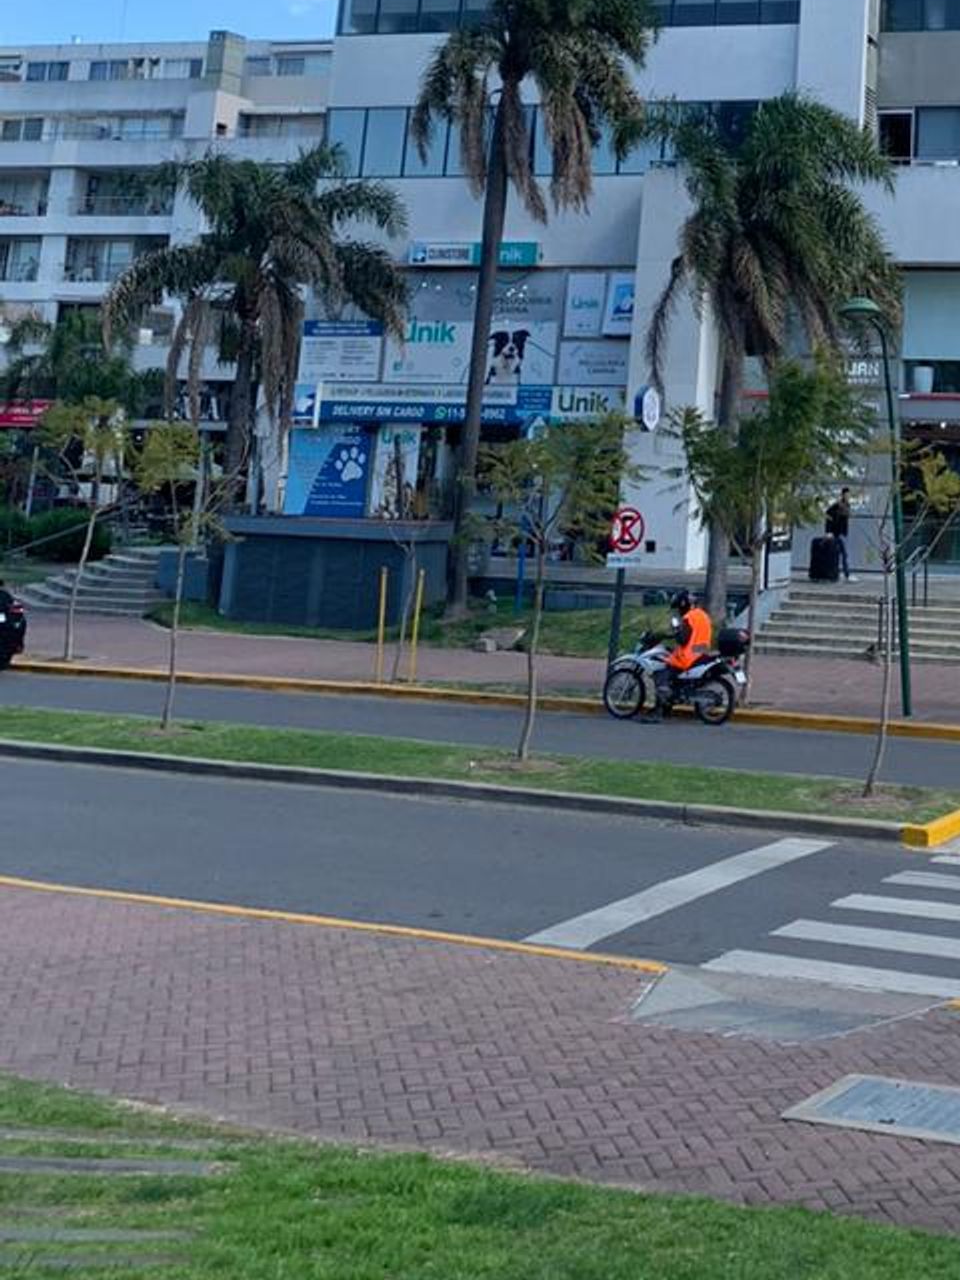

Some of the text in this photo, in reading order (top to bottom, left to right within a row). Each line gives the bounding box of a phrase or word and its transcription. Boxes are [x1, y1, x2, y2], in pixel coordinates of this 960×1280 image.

[558, 391, 609, 413] Unik
[332, 405, 375, 417] DELIVERY
[394, 407, 425, 418] CARGO
[382, 427, 417, 445] Uik
